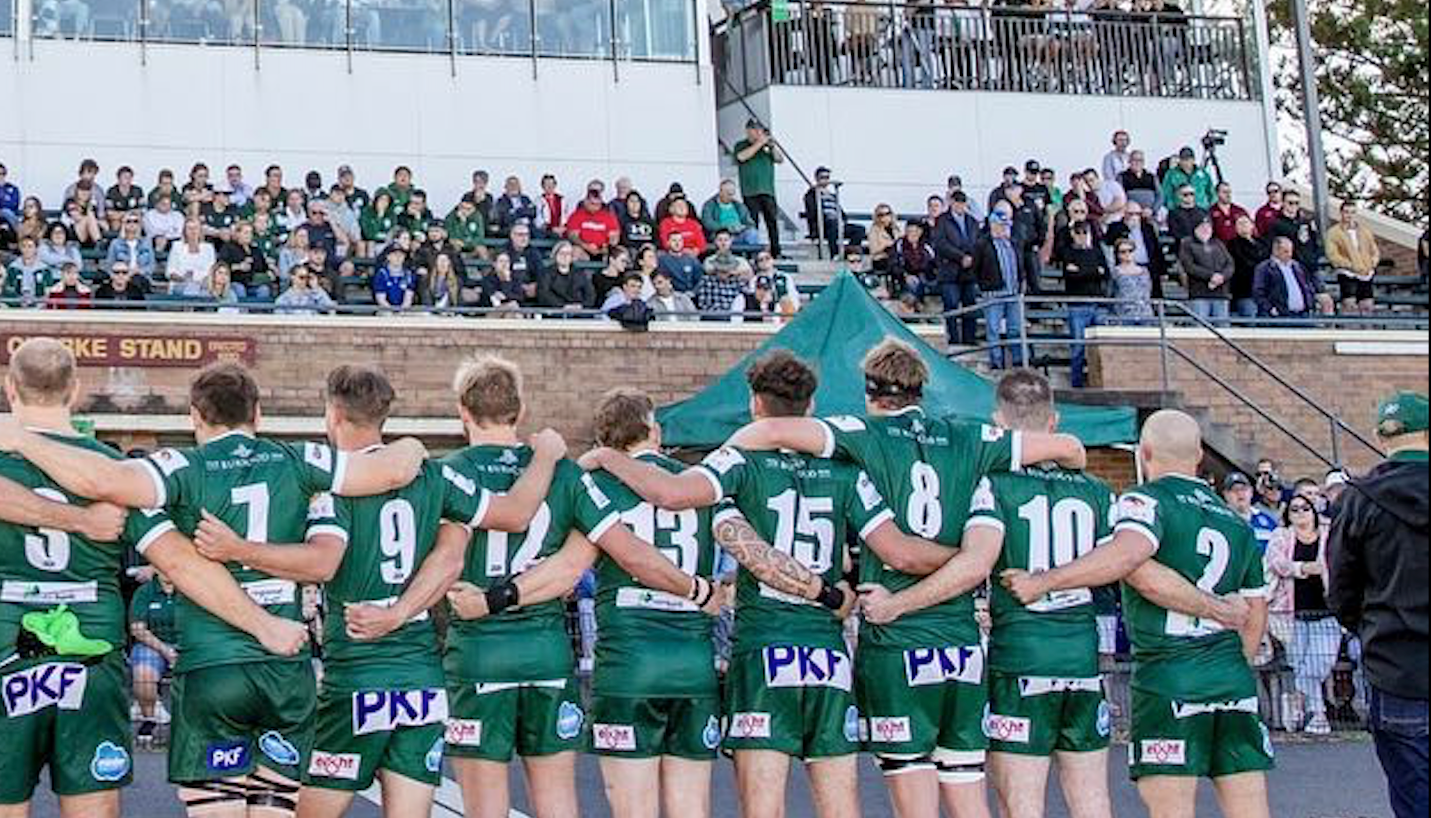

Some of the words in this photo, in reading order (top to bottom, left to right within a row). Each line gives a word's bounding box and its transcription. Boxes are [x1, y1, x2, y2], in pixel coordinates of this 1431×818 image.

[7, 336, 107, 357] CRKE
[120, 338, 202, 359] STAND
[231, 482, 270, 570] 7
[486, 491, 552, 577] 12
[767, 488, 834, 574] 15
[908, 460, 942, 538] 8
[1018, 495, 1095, 574] 10
[380, 499, 417, 584] 9
[620, 502, 699, 581] 13
[1196, 527, 1230, 594] 2
[6, 666, 83, 712] PKF
[768, 646, 841, 682] PKF
[356, 691, 437, 730] PKF
[212, 747, 243, 767] PKF
